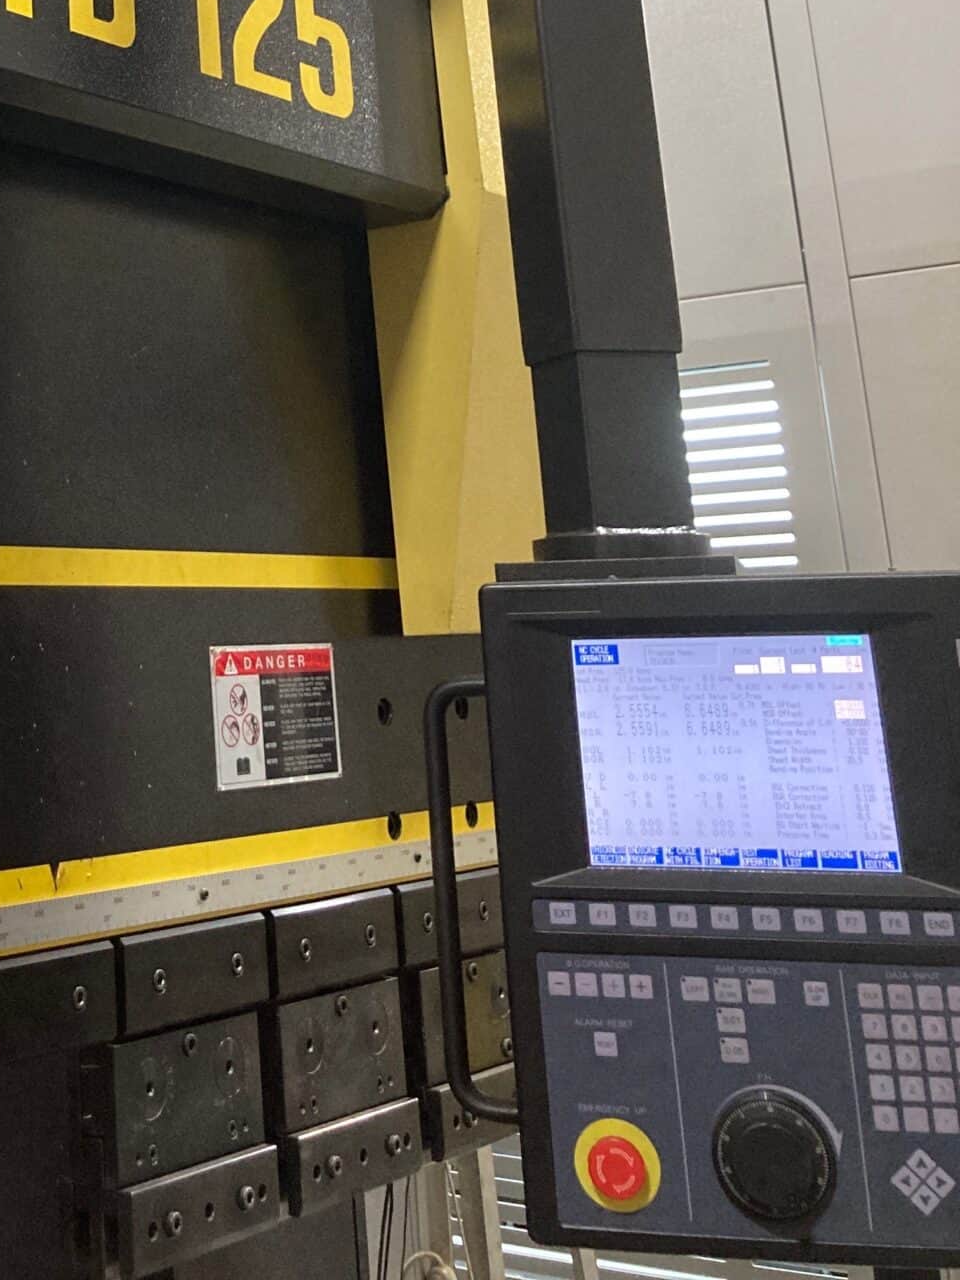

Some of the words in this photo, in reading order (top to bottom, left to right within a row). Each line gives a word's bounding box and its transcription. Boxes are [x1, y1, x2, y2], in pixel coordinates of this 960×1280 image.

[243, 654, 306, 670] DANGER
[553, 908, 571, 918] EXT
[596, 910, 609, 920] F1
[635, 910, 649, 920] F2
[676, 911, 689, 921] F3
[717, 912, 731, 922] F4
[759, 914, 773, 924] F5
[844, 916, 858, 926] F7
[928, 919, 950, 929] END
